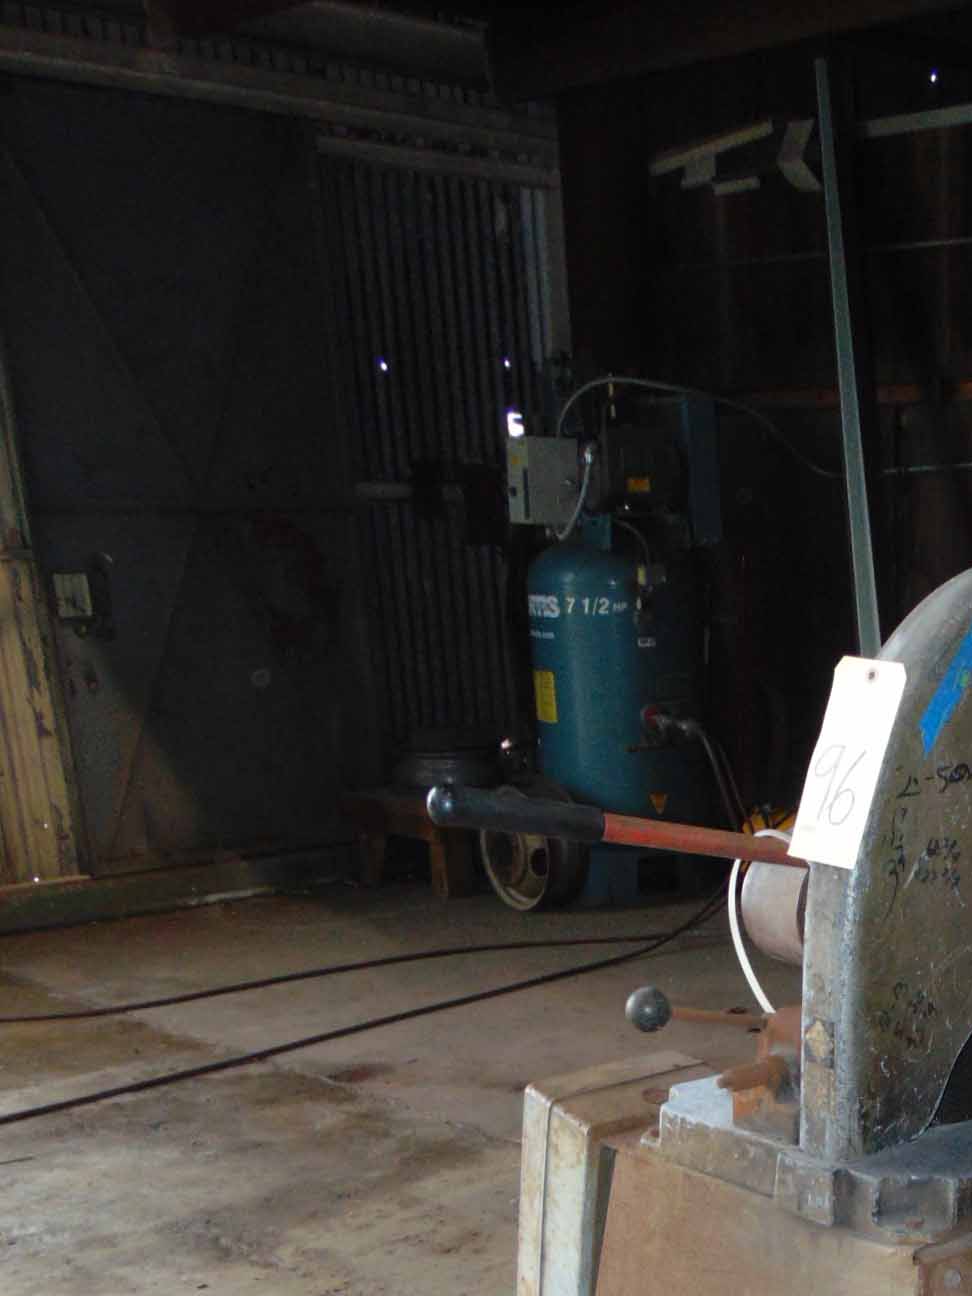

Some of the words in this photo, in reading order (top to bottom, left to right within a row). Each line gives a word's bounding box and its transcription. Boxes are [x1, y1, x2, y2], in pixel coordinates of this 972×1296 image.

[565, 597, 576, 615] 7
[582, 597, 610, 616] 1/2
[815, 743, 867, 826] 96
